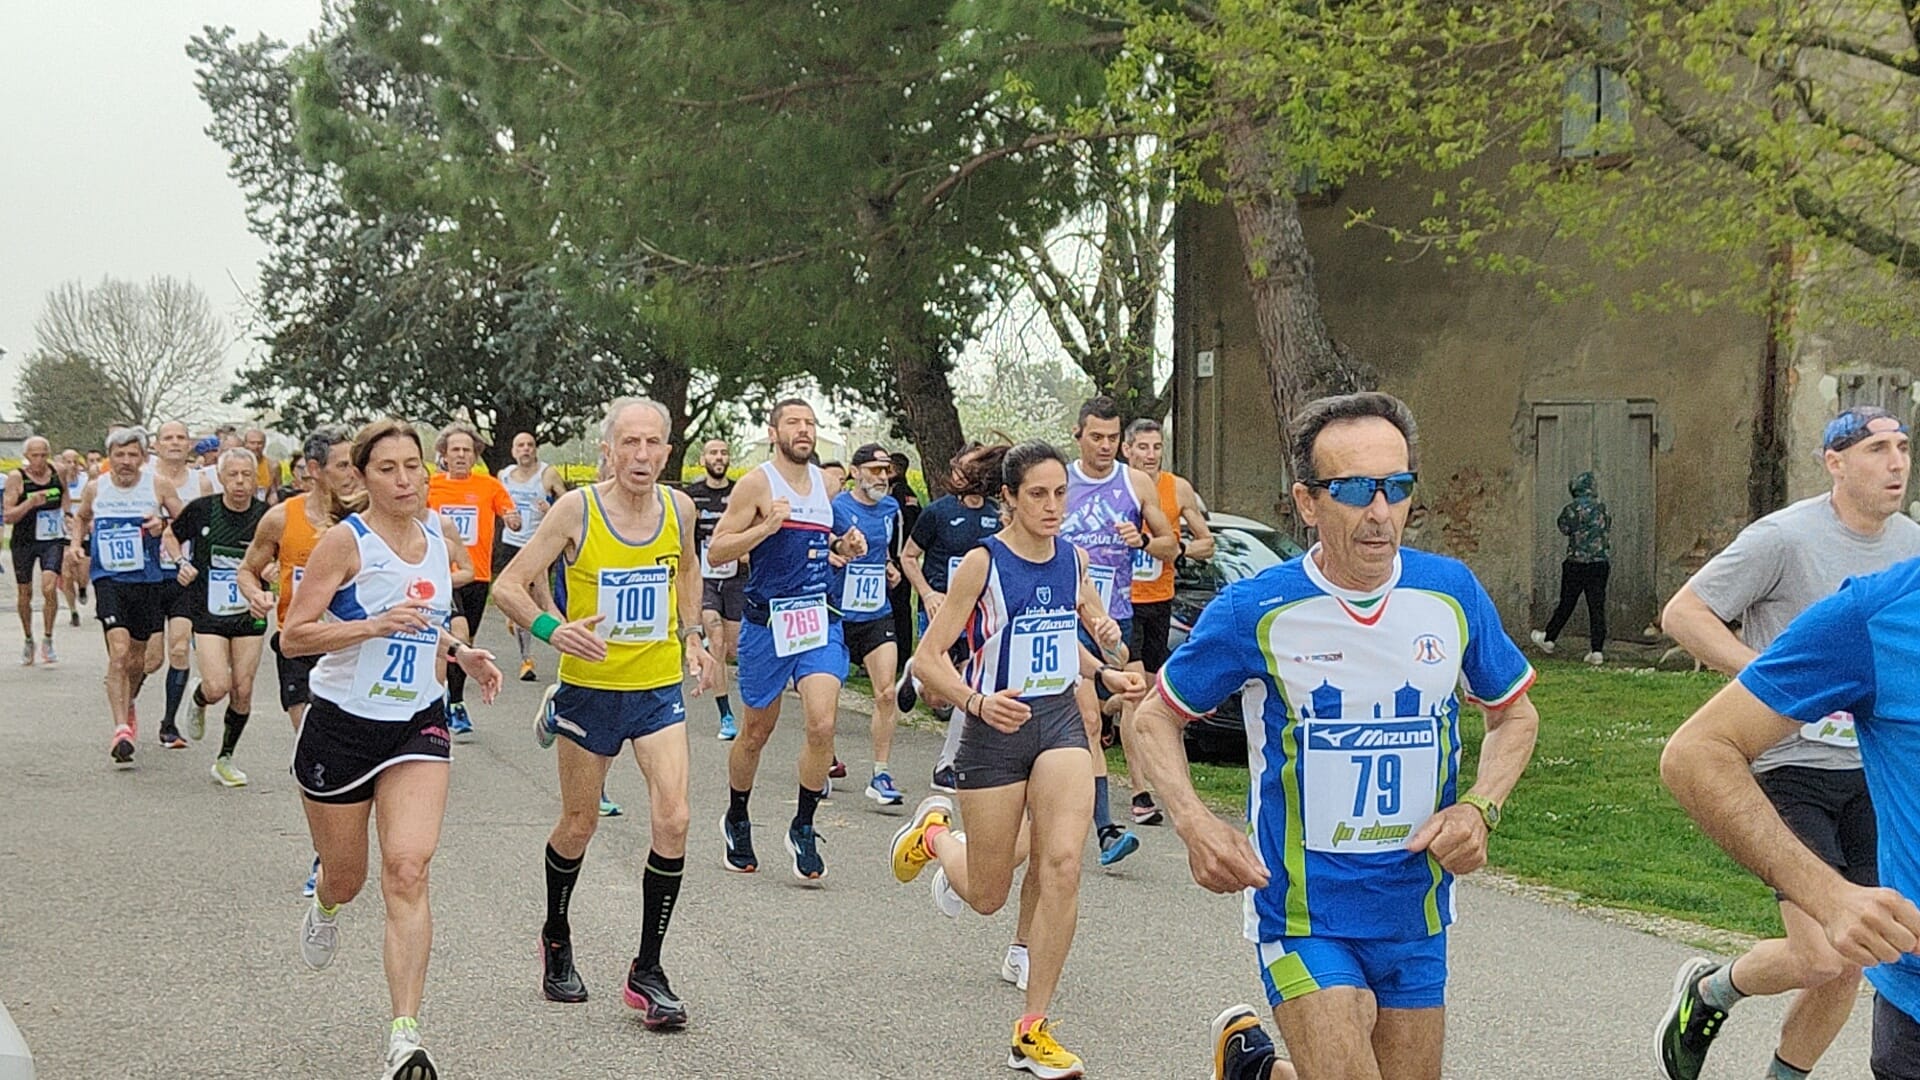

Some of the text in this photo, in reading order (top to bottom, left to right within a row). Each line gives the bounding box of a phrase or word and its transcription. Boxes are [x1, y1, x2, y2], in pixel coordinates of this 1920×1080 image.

[108, 540, 135, 560] 139
[616, 586, 656, 623] 100
[856, 577, 879, 599] 142
[782, 608, 821, 640] 269
[382, 643, 417, 684] 28
[1031, 634, 1058, 674] 95
[1351, 754, 1402, 818] 79
